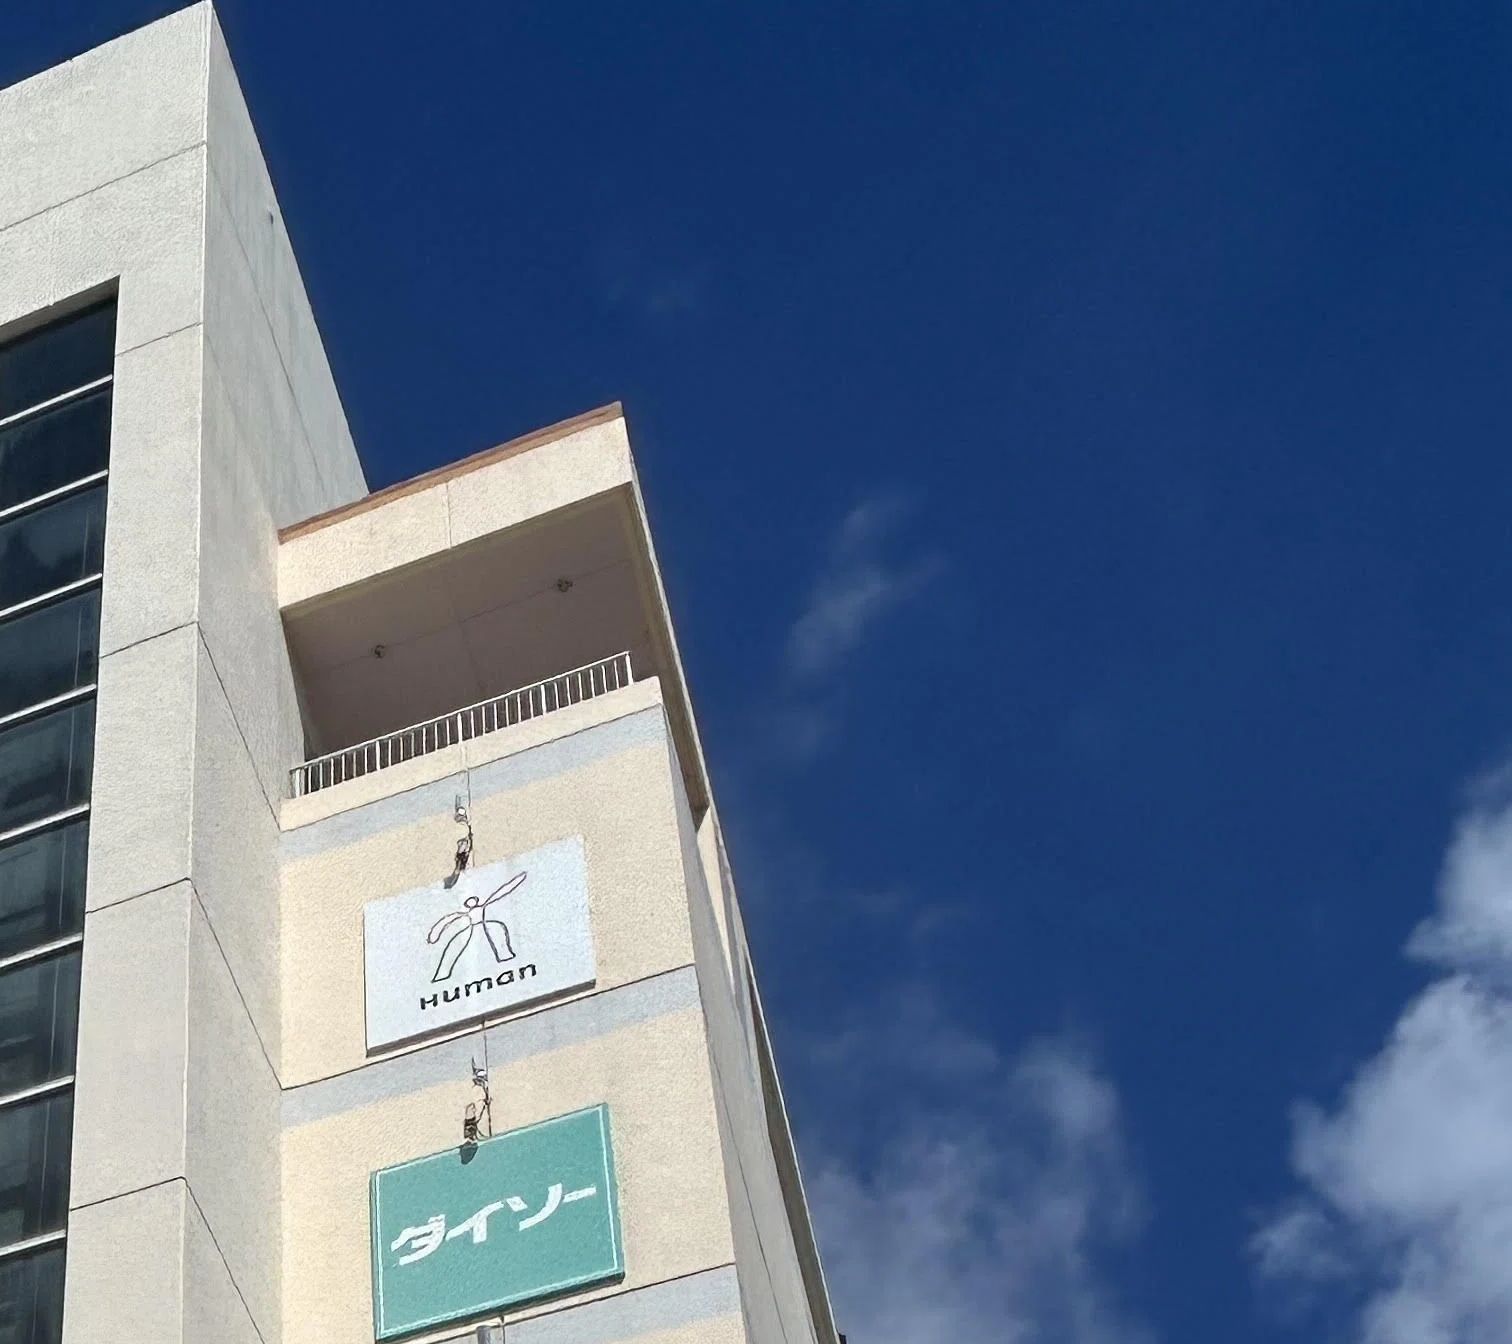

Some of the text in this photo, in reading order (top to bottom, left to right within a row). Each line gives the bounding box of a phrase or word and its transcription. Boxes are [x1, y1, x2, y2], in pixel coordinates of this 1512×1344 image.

[419, 962, 537, 1010] Human
[391, 1183, 597, 1267] ダイソー
